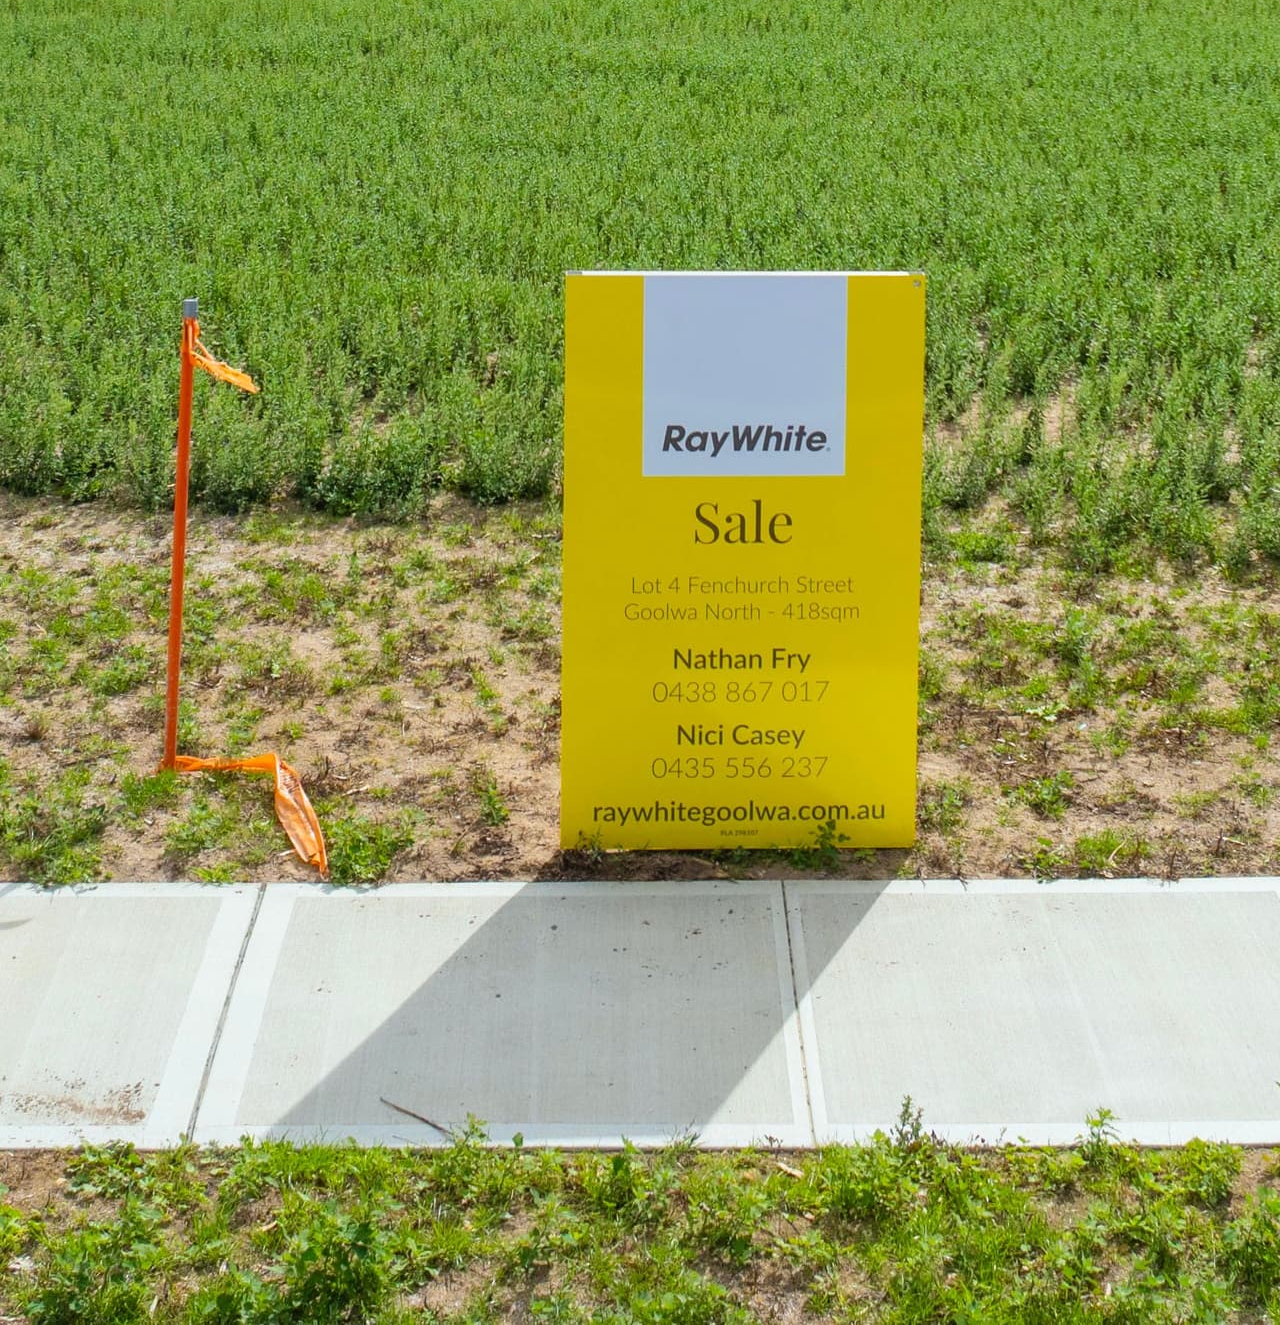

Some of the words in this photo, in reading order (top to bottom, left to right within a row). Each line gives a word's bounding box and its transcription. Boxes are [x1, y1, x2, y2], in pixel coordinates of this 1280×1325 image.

[694, 499, 793, 545] Sale
[631, 576, 663, 594] Lot
[668, 576, 681, 594] 4
[687, 575, 789, 594] Fenchurch
[796, 575, 854, 594] Street
[624, 602, 698, 621] Goolwa
[705, 602, 761, 621] North
[782, 602, 860, 624] 418sqm
[673, 647, 763, 670] Nathan
[771, 647, 811, 674] Fry
[652, 681, 717, 704] 0438
[725, 681, 774, 703] 867
[782, 680, 830, 703] 017
[676, 724, 724, 746] Nici
[732, 724, 805, 750] Casey
[651, 757, 715, 779] 0435
[725, 756, 772, 779] 556
[781, 755, 828, 779] 237
[593, 799, 885, 826] raywhitegoolwa.com.au
